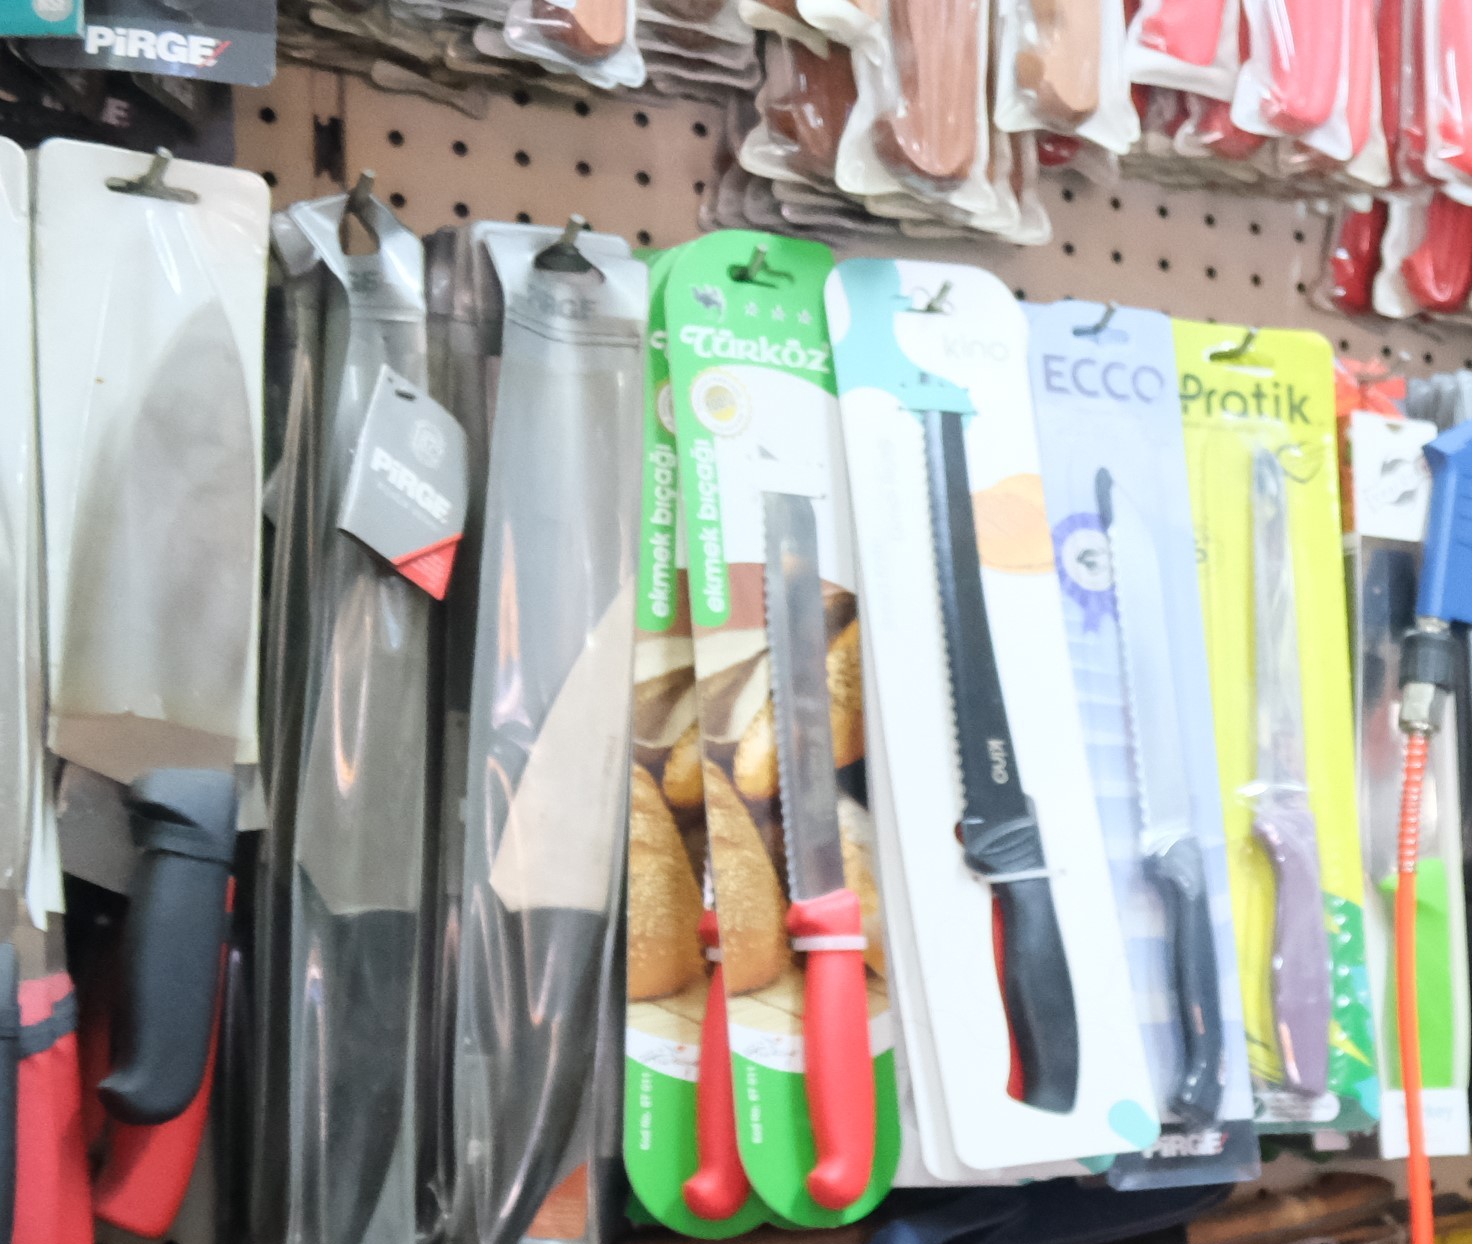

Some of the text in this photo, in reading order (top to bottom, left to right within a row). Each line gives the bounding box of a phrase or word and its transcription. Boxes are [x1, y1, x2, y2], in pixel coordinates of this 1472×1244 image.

[1042, 353, 1165, 405] ECCO
[1179, 372, 1312, 426] Pratik
[648, 534, 673, 619] ekmek
[698, 527, 727, 614] ekmek
